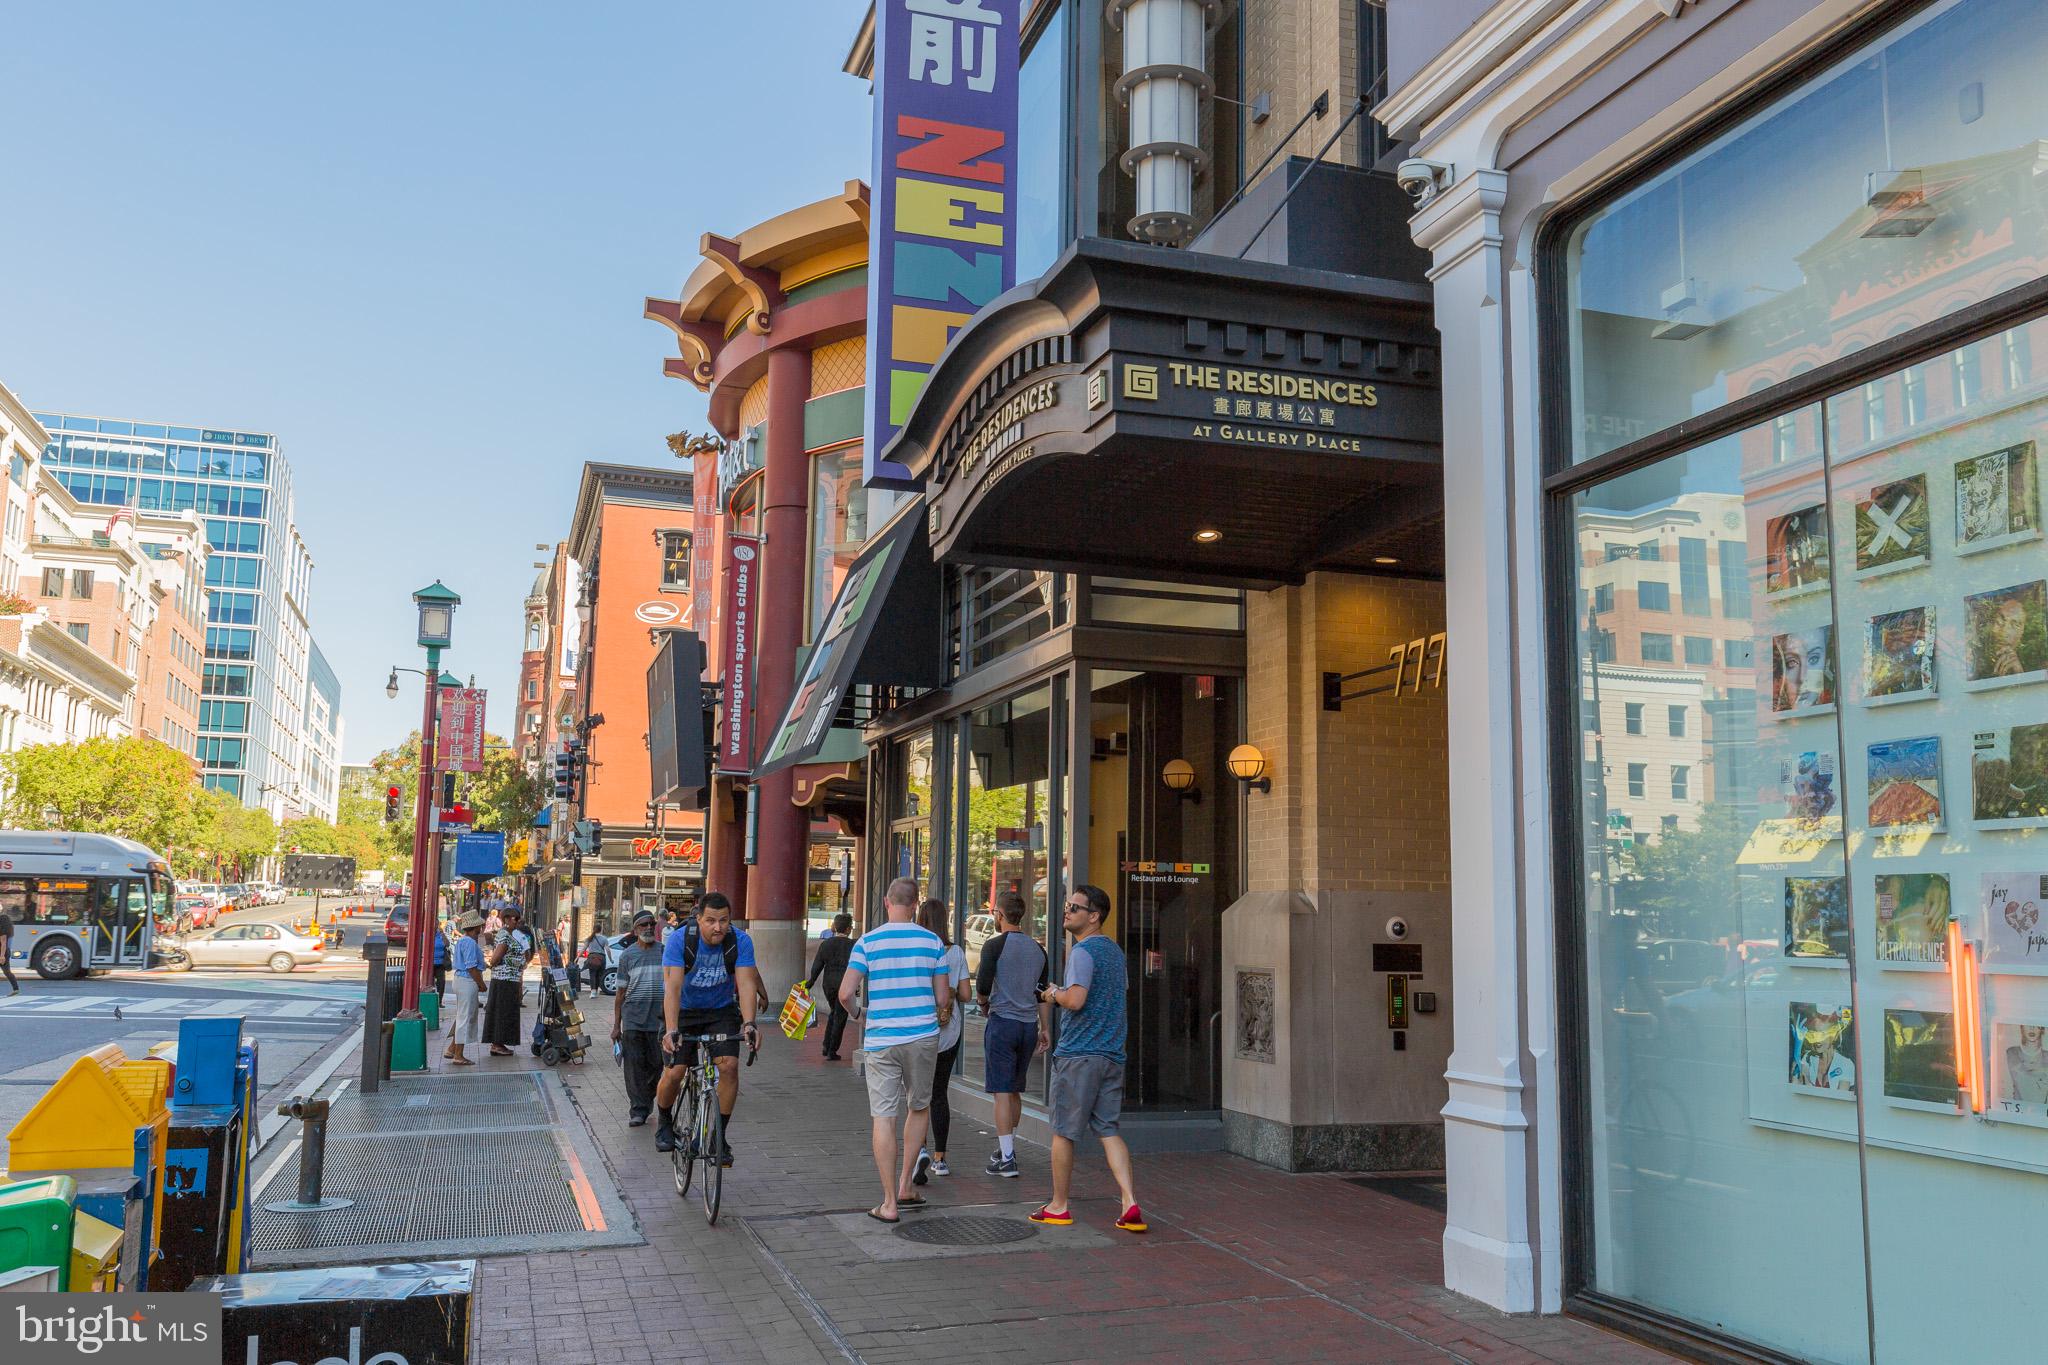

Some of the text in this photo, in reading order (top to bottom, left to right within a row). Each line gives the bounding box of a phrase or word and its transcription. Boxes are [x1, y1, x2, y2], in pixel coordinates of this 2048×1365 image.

[1169, 362, 1378, 406] THE RESIDENCES
[1213, 396, 1337, 427] 畫廊廣場公寓
[959, 437, 983, 479] THE
[980, 381, 1057, 450] RESIDENCES
[1193, 425, 1361, 452] AT GALLERY PLACE
[989, 460, 1013, 484] GALLERY
[1012, 446, 1035, 465] PLACE
[730, 564, 748, 756] washington sports clubs
[1389, 632, 1447, 697] 777
[1131, 874, 1199, 884] Restaurant & Lounge
[1990, 884, 2008, 909] jay
[1879, 942, 1945, 962] ULTRAVIOLENCE
